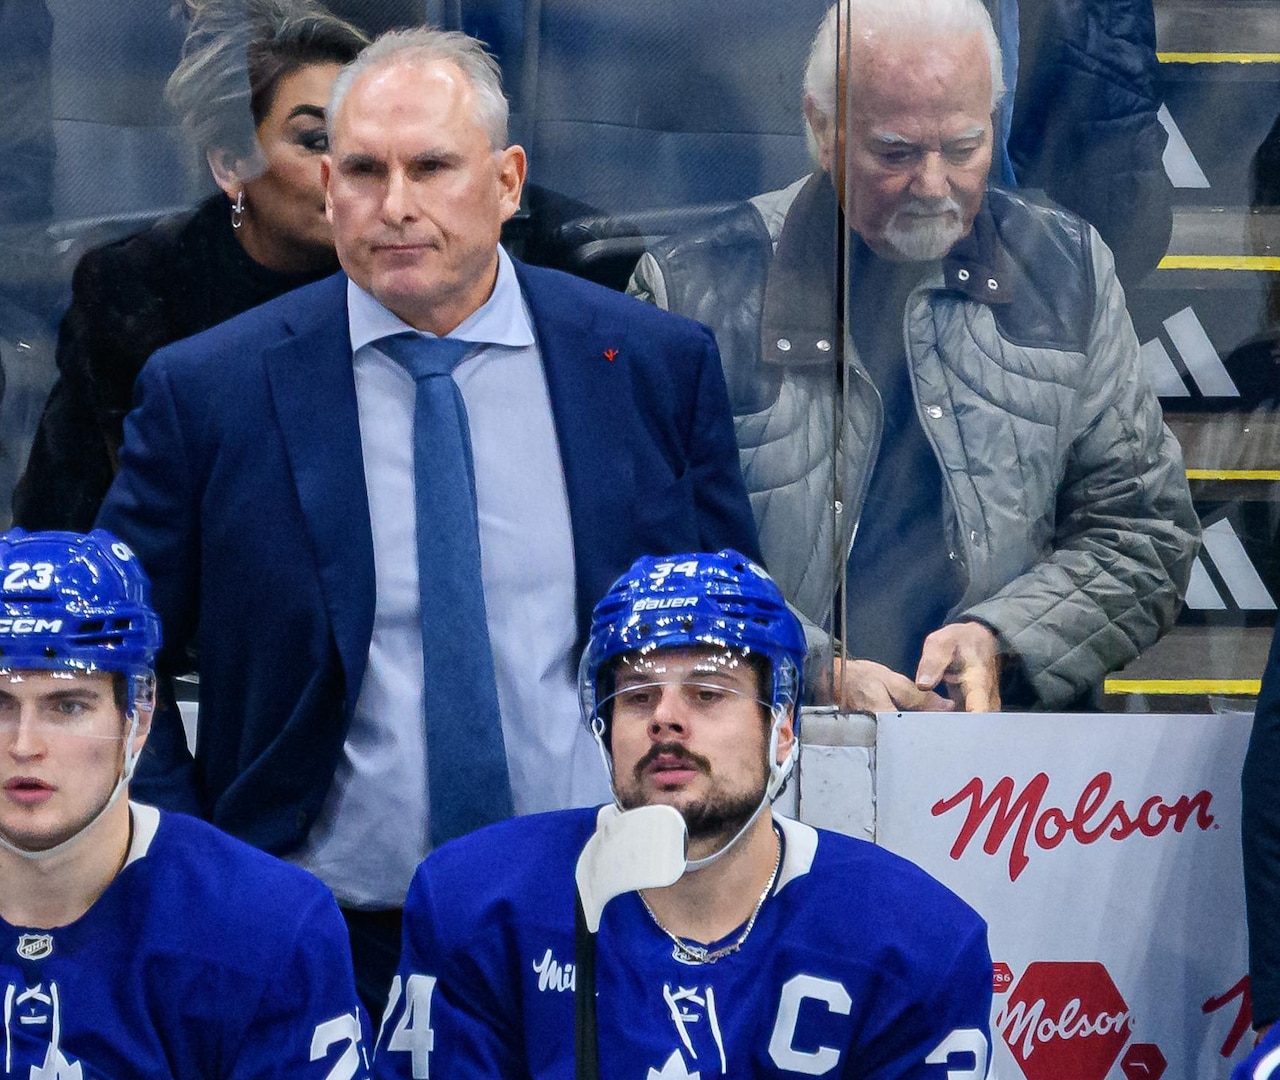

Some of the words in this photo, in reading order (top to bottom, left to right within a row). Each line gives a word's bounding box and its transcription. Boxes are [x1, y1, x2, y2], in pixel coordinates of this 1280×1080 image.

[3, 562, 55, 590] 23
[649, 560, 699, 580] 34
[632, 597, 699, 612] BAUER
[931, 772, 1215, 881] Molson
[532, 949, 598, 995] Mil
[768, 973, 852, 1075] C
[996, 998, 1134, 1060] Molson
